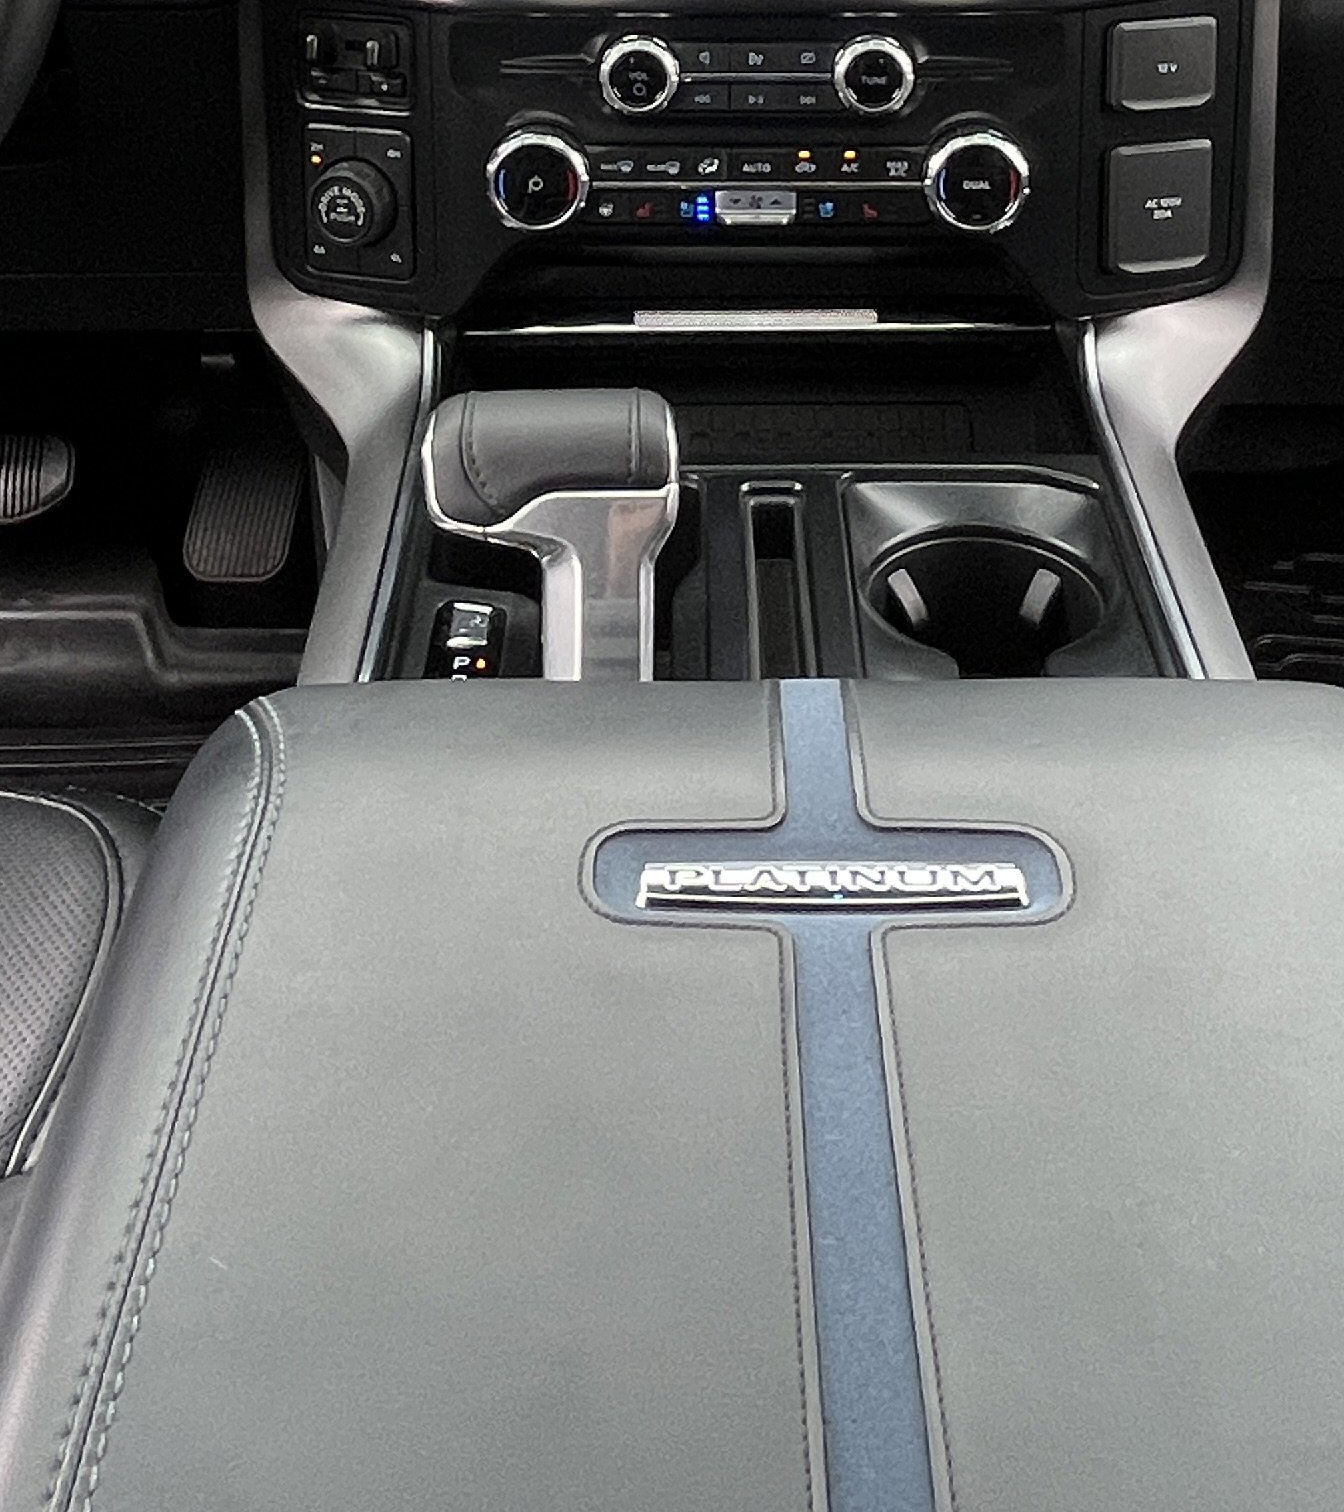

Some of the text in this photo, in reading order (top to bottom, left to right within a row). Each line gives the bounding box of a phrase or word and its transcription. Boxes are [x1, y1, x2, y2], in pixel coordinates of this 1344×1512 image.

[860, 75, 887, 86] TUNE
[742, 162, 772, 174] AUTO
[840, 162, 860, 174] A/C
[962, 179, 992, 190] DUAL
[452, 655, 472, 670] P
[664, 864, 1001, 893] PLATINUM
